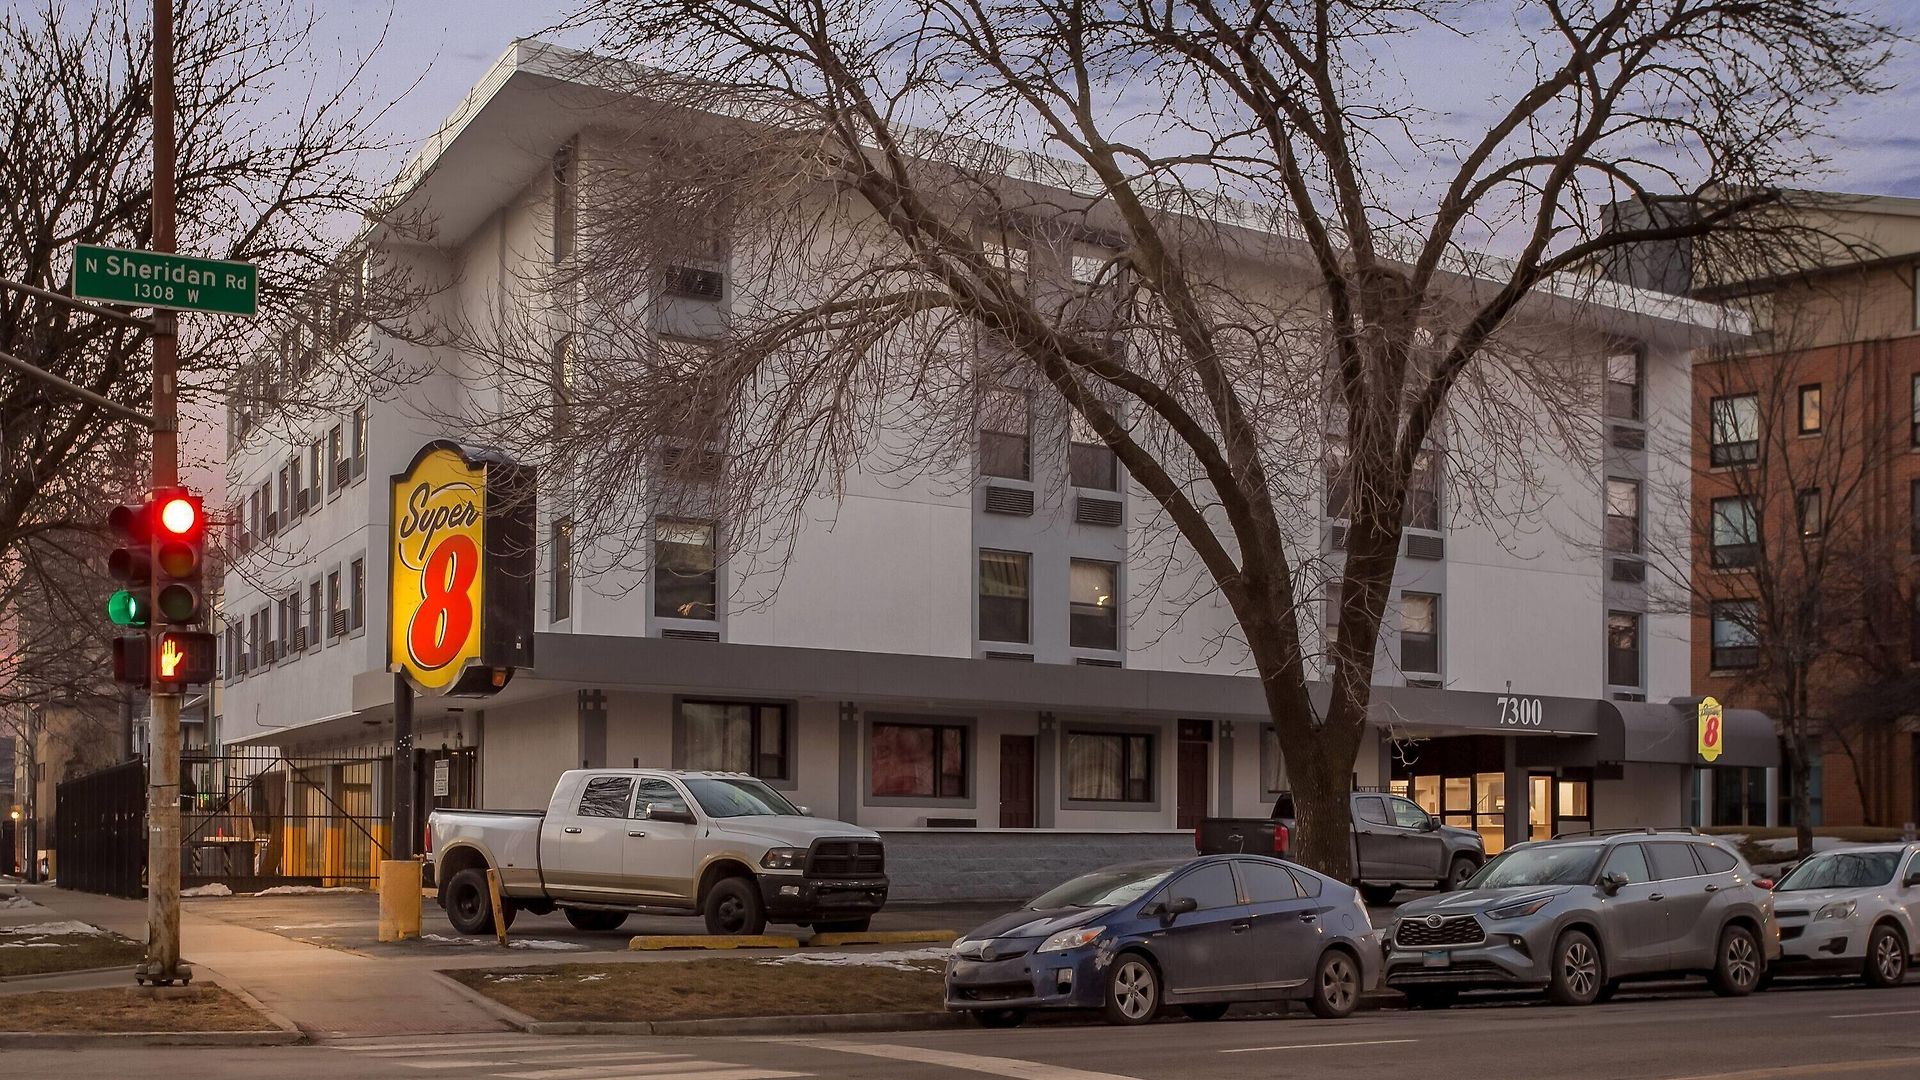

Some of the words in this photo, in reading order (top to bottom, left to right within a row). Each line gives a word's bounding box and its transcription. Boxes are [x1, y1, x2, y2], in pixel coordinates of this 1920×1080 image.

[85, 257, 98, 274] N
[106, 255, 216, 287] Sheridan
[225, 274, 247, 290] Rd
[134, 283, 174, 301] 1308
[187, 289, 200, 303] W
[400, 481, 480, 561] Super
[407, 534, 479, 671] 8
[1497, 697, 1543, 726] 7300
[1703, 716, 1719, 748] 8
